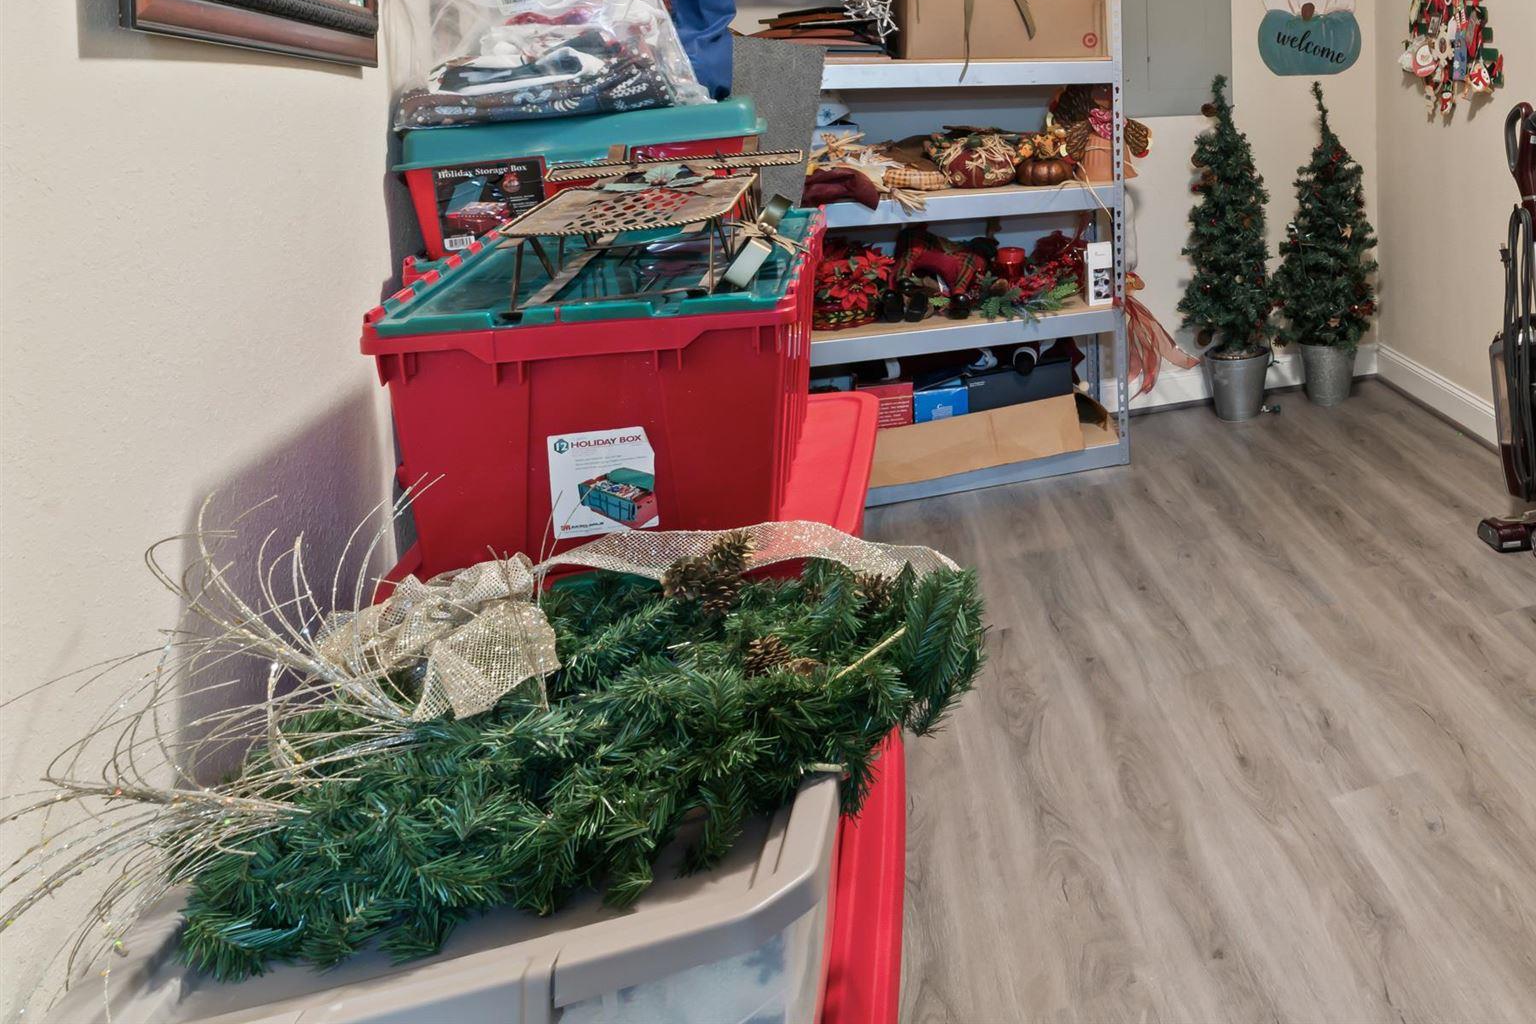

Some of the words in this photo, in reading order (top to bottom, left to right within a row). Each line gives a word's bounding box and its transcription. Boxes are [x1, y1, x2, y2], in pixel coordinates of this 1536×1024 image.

[1276, 30, 1347, 64] welcome
[438, 168, 472, 179] Holiday
[475, 166, 508, 176] Storage
[571, 437, 616, 448] HOLIDAY
[620, 435, 641, 443] BOX
